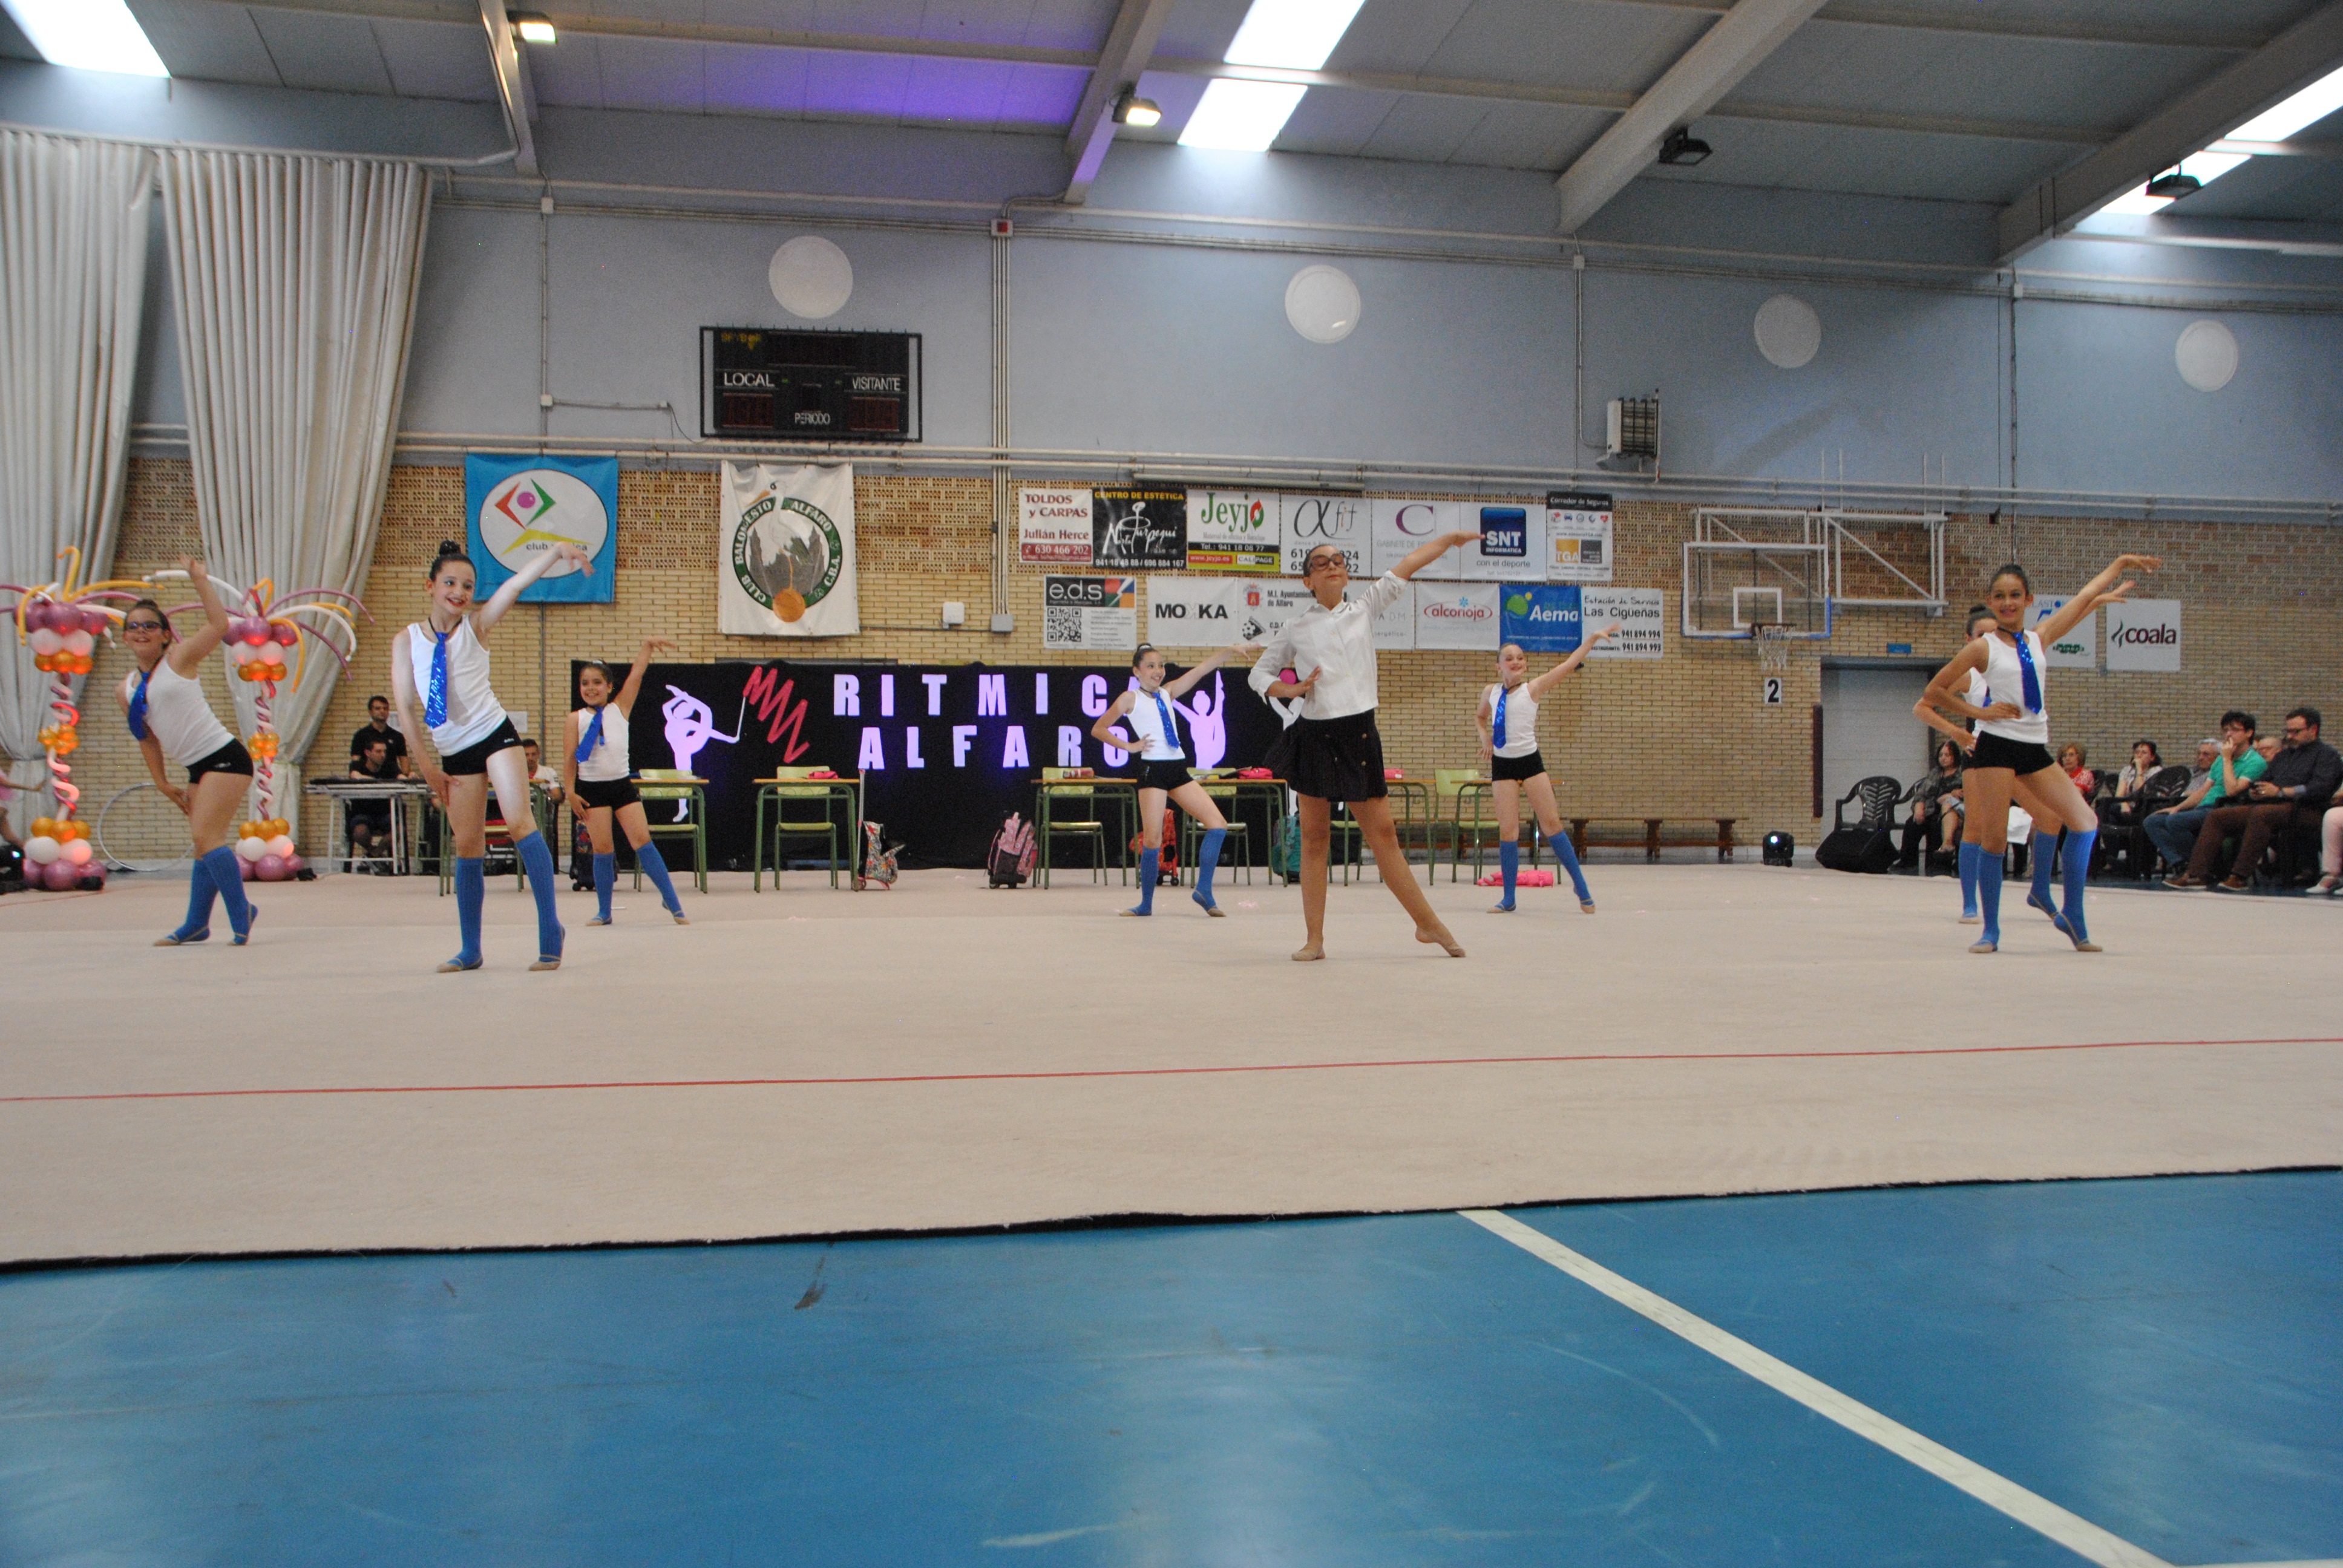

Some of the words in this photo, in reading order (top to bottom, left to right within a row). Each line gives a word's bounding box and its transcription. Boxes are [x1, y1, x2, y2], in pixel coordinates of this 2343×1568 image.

[724, 373, 775, 387] LOCAL
[852, 376, 901, 391] VISITANTE
[1024, 494, 1073, 504] TOLDOS
[1587, 498, 1609, 507] Seguros
[1029, 509, 1036, 518] y
[1040, 508, 1088, 518] CARPAS
[1023, 528, 1055, 540] Julián
[1059, 529, 1089, 540] Herce
[1486, 531, 1522, 547] SNT
[526, 542, 548, 550] club
[741, 574, 767, 603] CLUB
[790, 498, 833, 532] ALFARO
[1120, 558, 1129, 567] 48
[1556, 551, 1579, 562] TGA
[1503, 560, 1530, 568] deporte
[1049, 580, 1103, 600] e.d.s
[1584, 595, 1616, 605] Estación
[1619, 596, 1628, 605] de
[1630, 596, 1660, 606] Servicio
[1432, 603, 1484, 621] alcorioja
[1529, 605, 1579, 622] Aema
[1584, 607, 1604, 616] Las
[1610, 607, 1660, 620] Cigüeñas
[1622, 630, 1633, 638] 941
[1634, 630, 1647, 638] 894
[1648, 630, 1660, 639] 994
[2125, 623, 2177, 644] coala
[1622, 643, 1634, 652] 941
[1635, 643, 1647, 652] 894
[1649, 643, 1661, 652] 993
[1768, 679, 1780, 703] 2
[857, 725, 1129, 770] ALFARO
